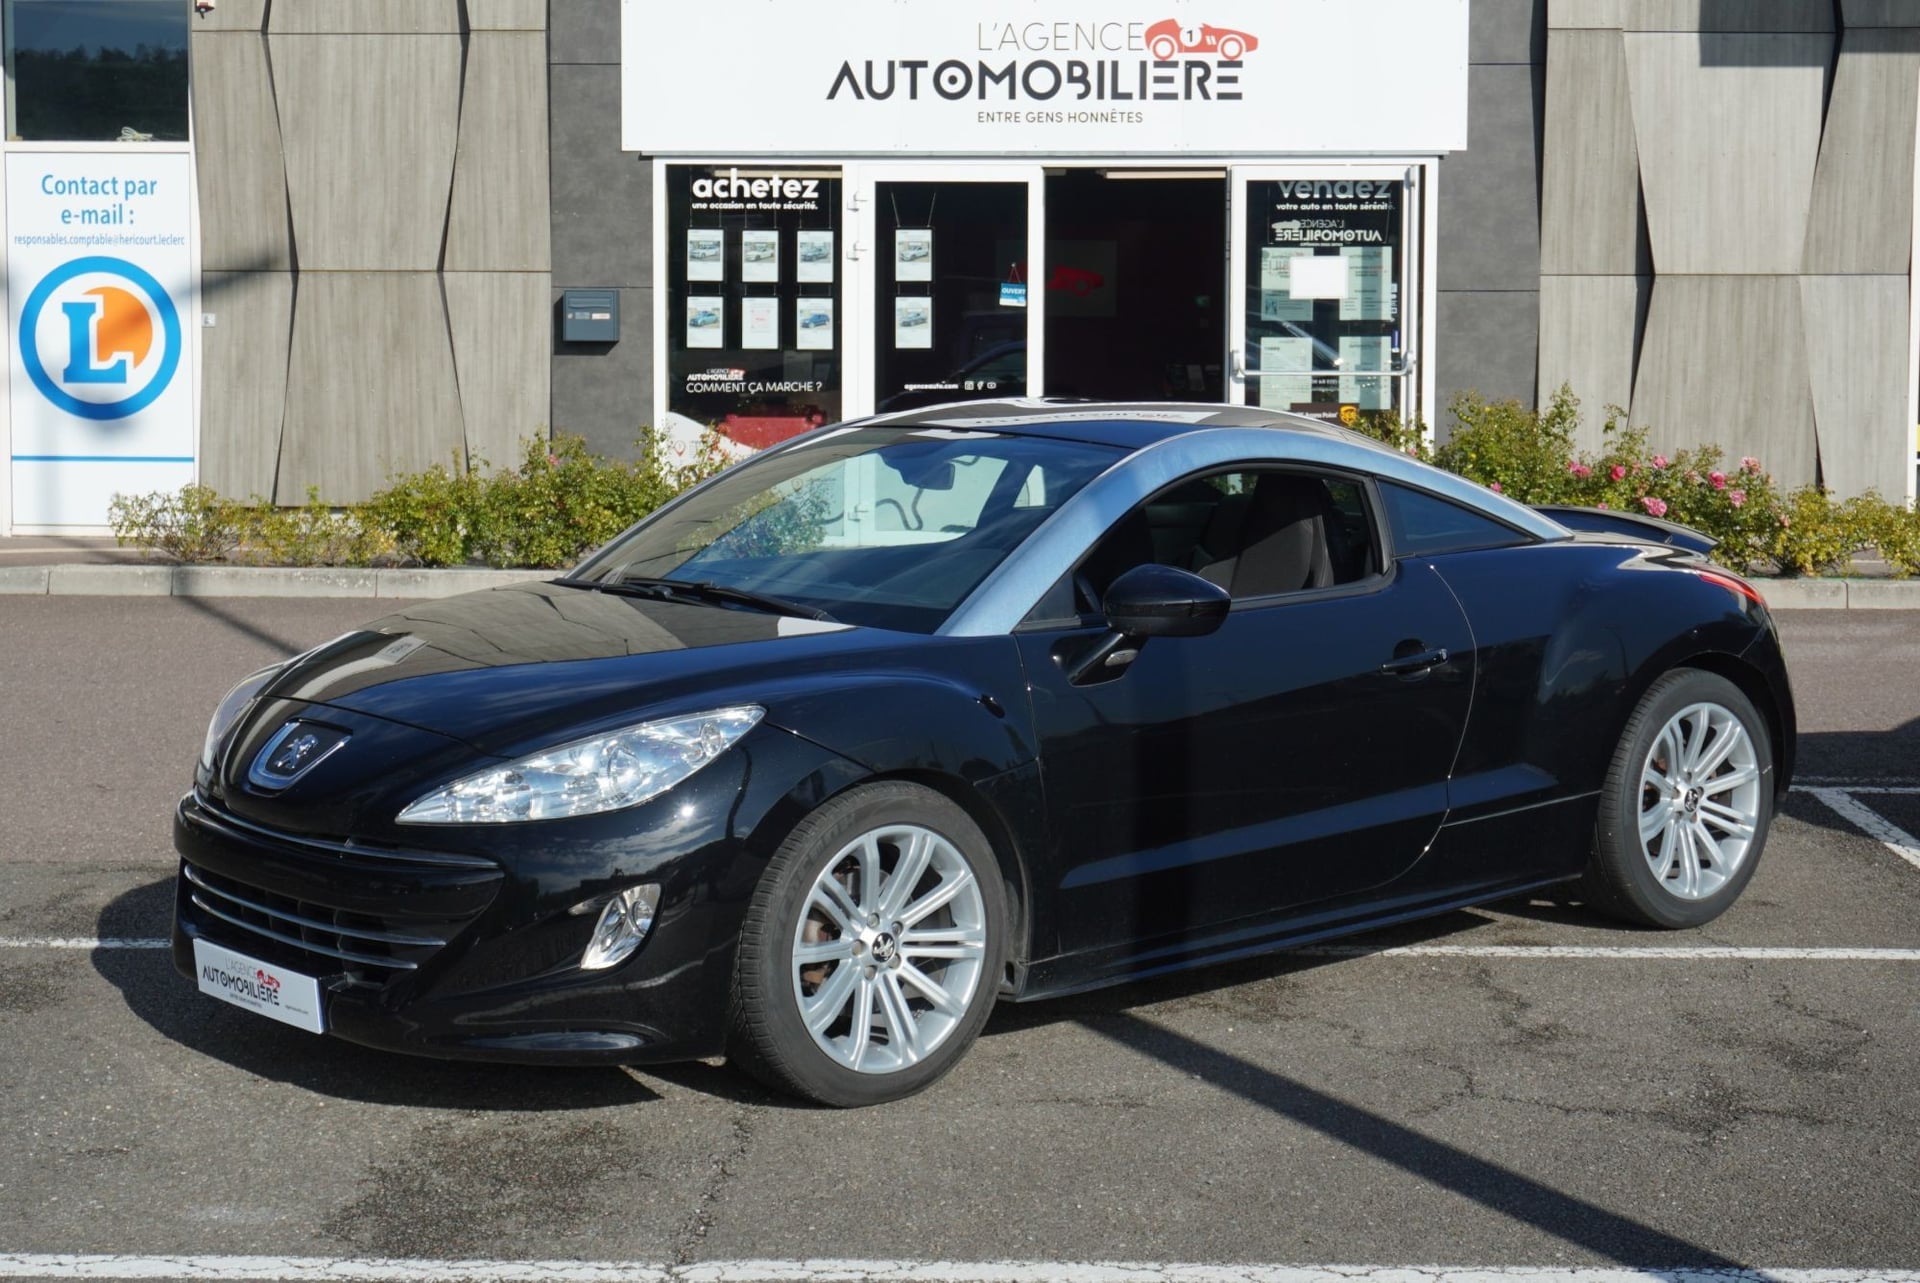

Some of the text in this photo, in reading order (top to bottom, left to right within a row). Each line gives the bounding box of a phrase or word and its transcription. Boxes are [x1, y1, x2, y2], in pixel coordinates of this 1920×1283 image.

[978, 22, 1144, 51] L'AGENCE
[1186, 29, 1195, 43] 1
[977, 108, 1144, 124] ENTRE GENS HONNÊTES
[41, 174, 158, 201] Contact par
[692, 167, 820, 199] achetez
[692, 200, 818, 210] une occasion en toute sécurité.
[1276, 202, 1299, 210] votre
[1300, 202, 1321, 210] auto
[1335, 202, 1358, 210] toute
[61, 203, 124, 225] e-mail
[1001, 287, 1026, 296] OUVERT
[686, 382, 746, 393] COMMENT
[747, 382, 764, 395] ÇA
[765, 381, 813, 393] MARCHE
